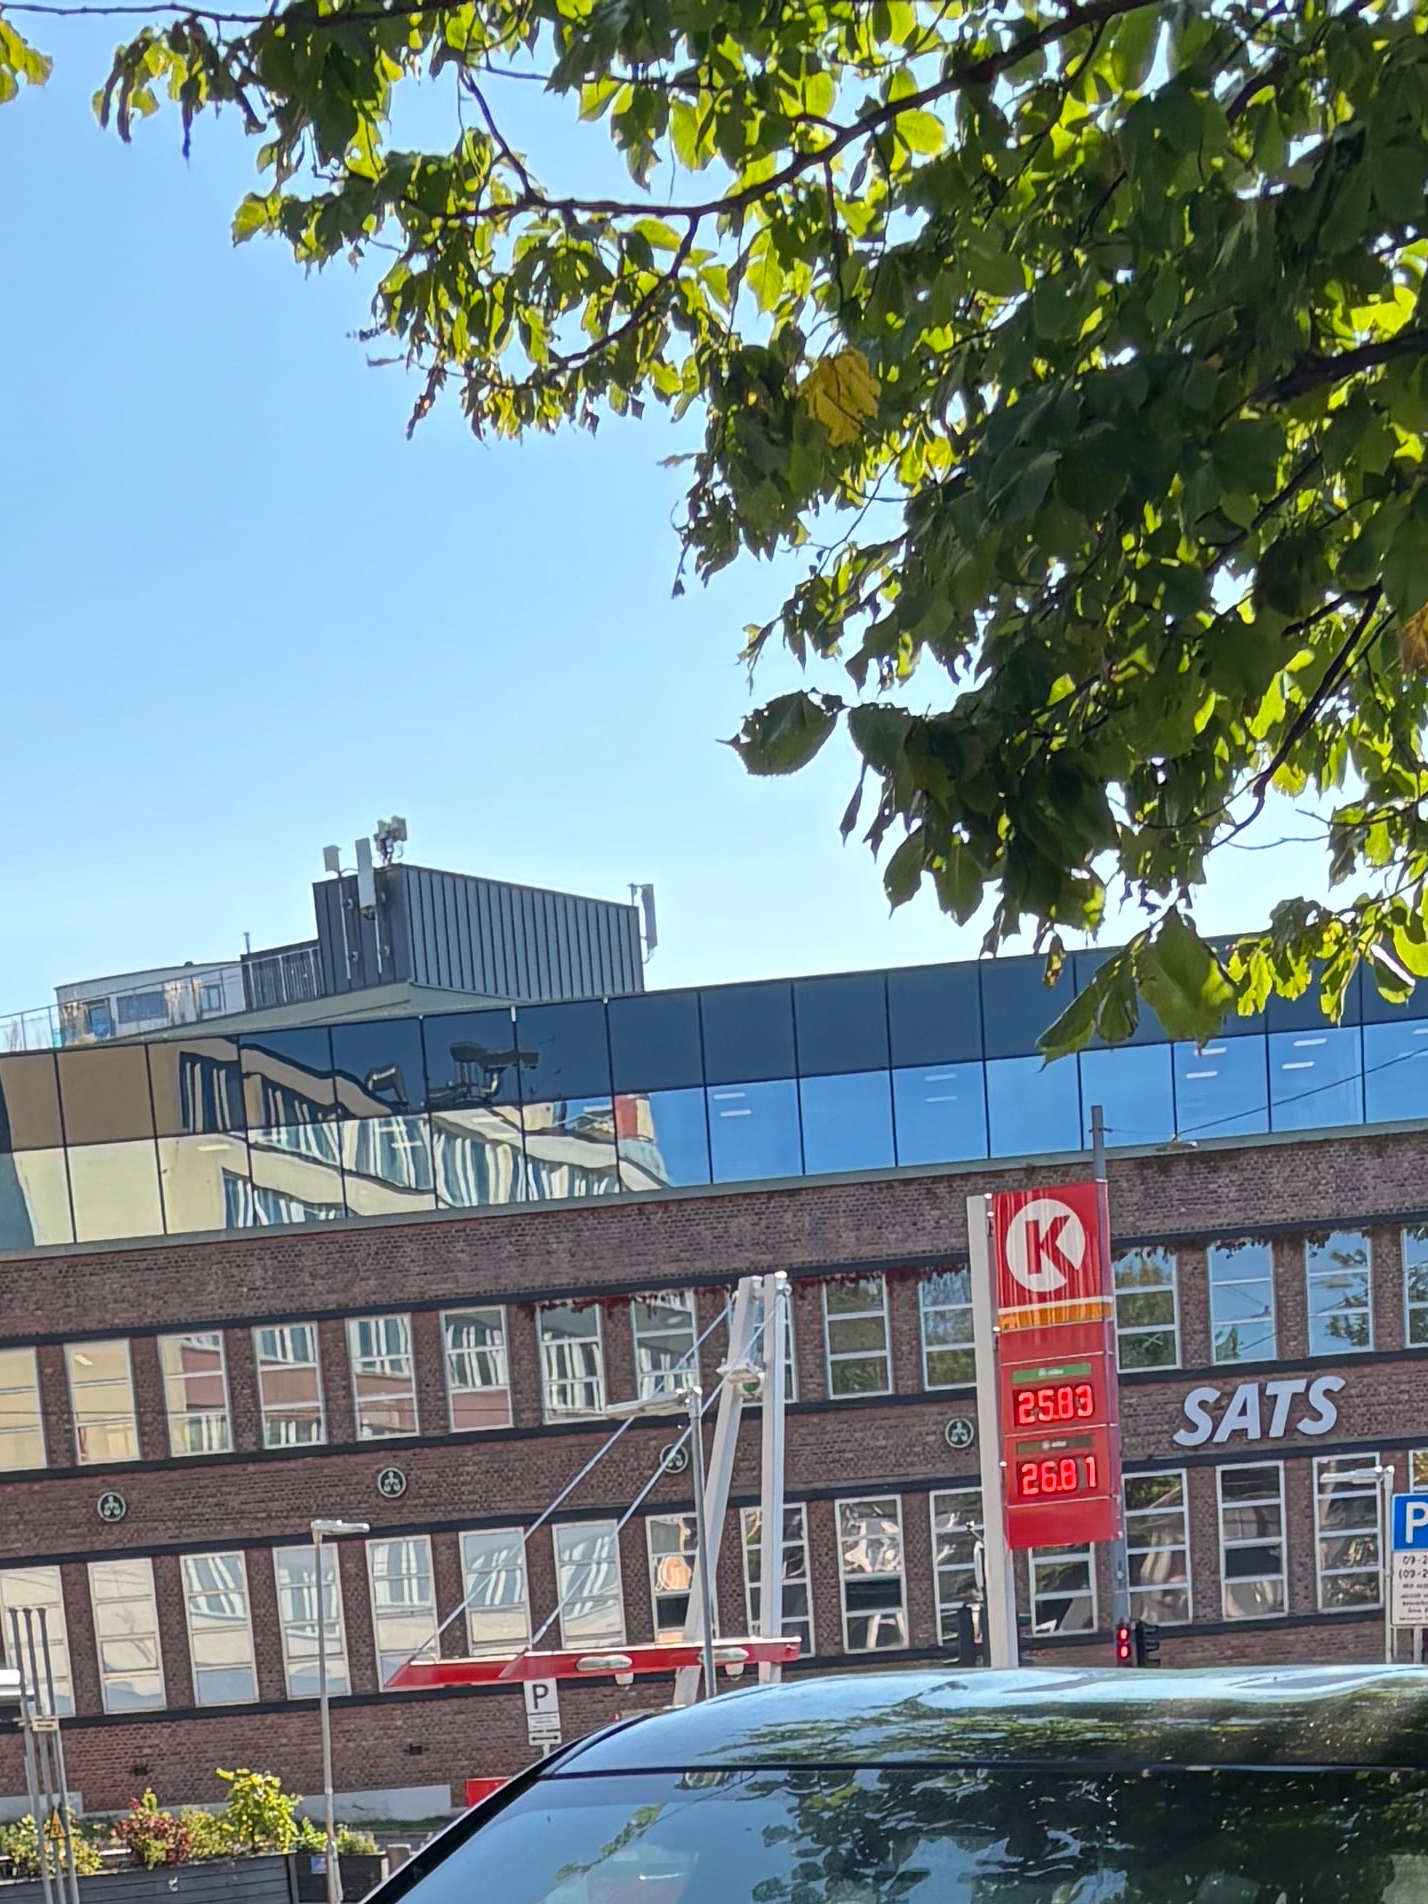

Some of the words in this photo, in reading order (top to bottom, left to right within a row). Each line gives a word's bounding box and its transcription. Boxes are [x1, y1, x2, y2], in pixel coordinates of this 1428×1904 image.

[1018, 1384, 1094, 1425] 25.83
[1172, 1375, 1347, 1447] SATS
[1021, 1455, 1097, 1495] 26.81
[532, 1684, 549, 1709] P
